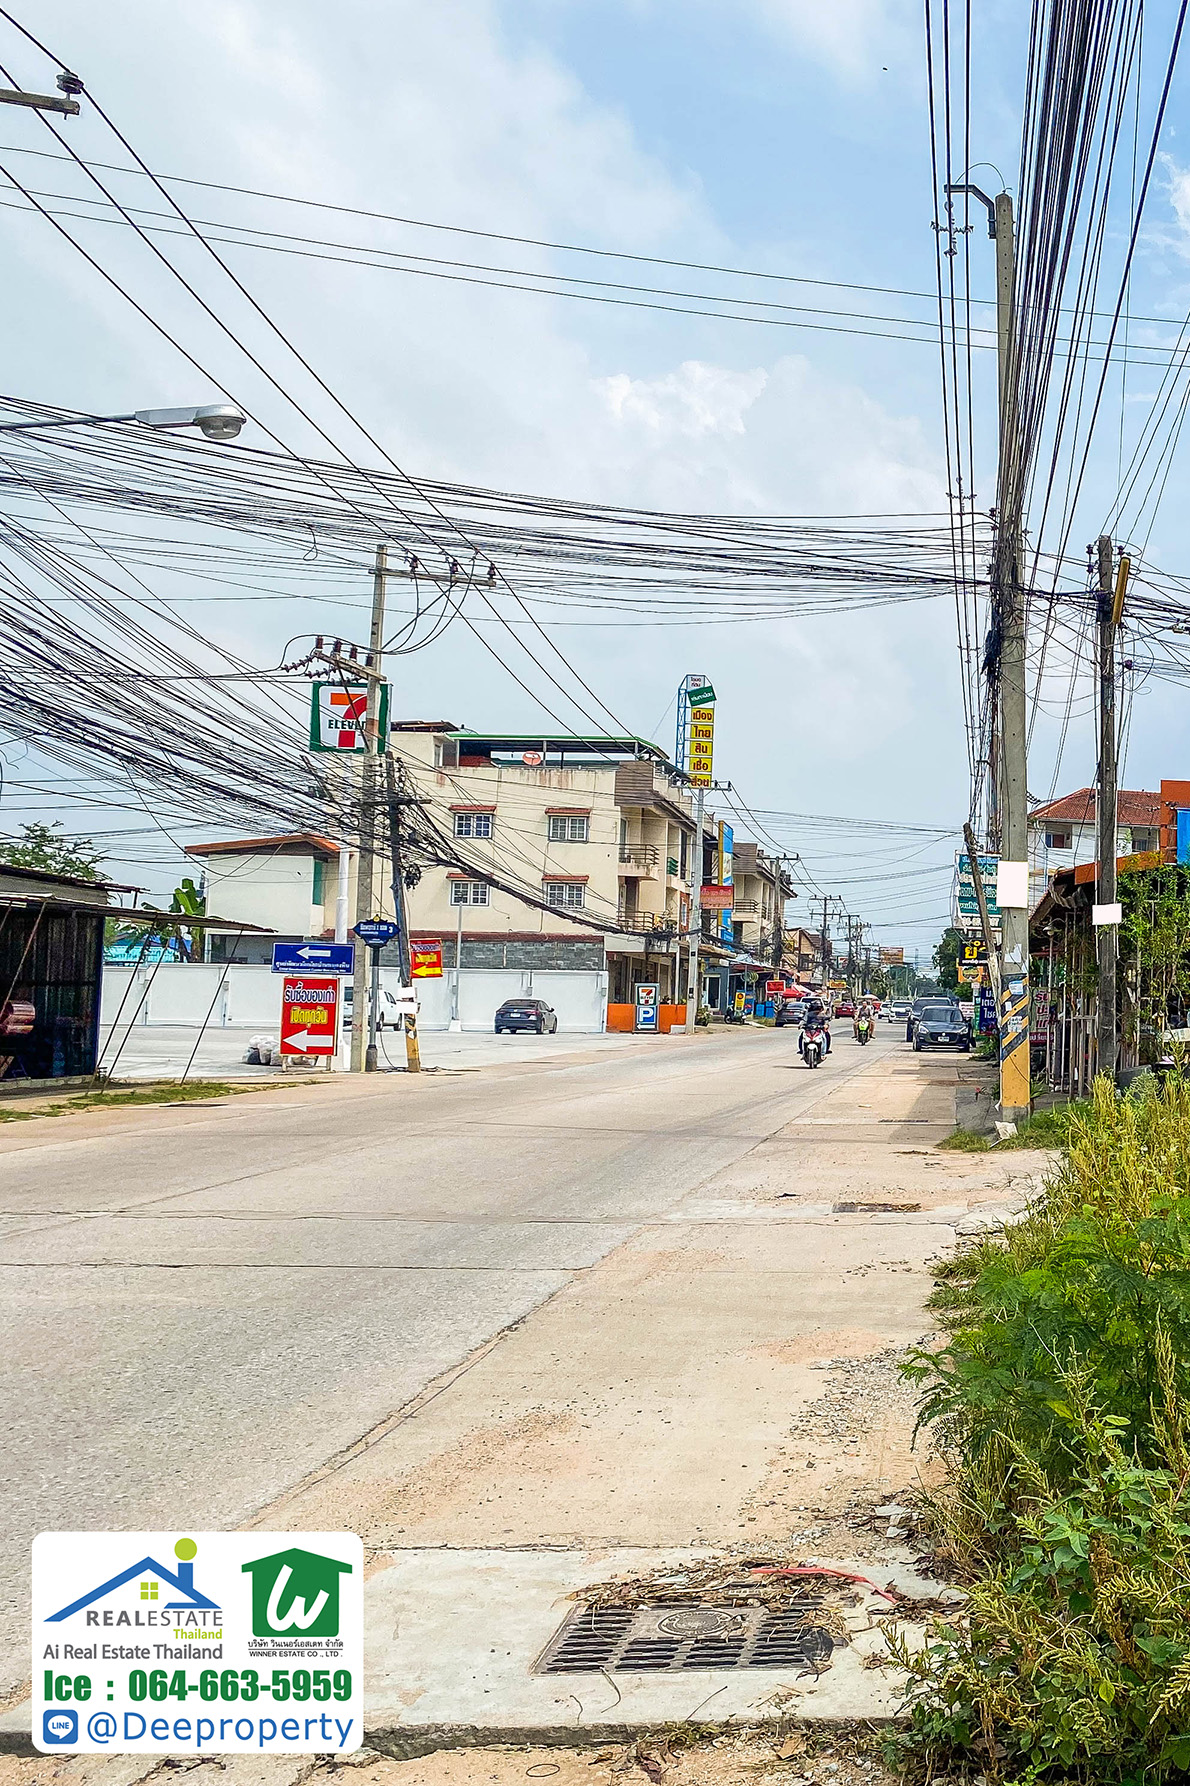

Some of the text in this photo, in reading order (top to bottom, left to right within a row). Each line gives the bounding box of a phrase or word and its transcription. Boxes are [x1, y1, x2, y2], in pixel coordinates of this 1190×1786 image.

[330, 693, 367, 748] 7
[284, 981, 336, 1004] รับซื้อของเก่า
[289, 1006, 328, 1028] เปิดทุกวัน
[639, 1007, 654, 1022] P
